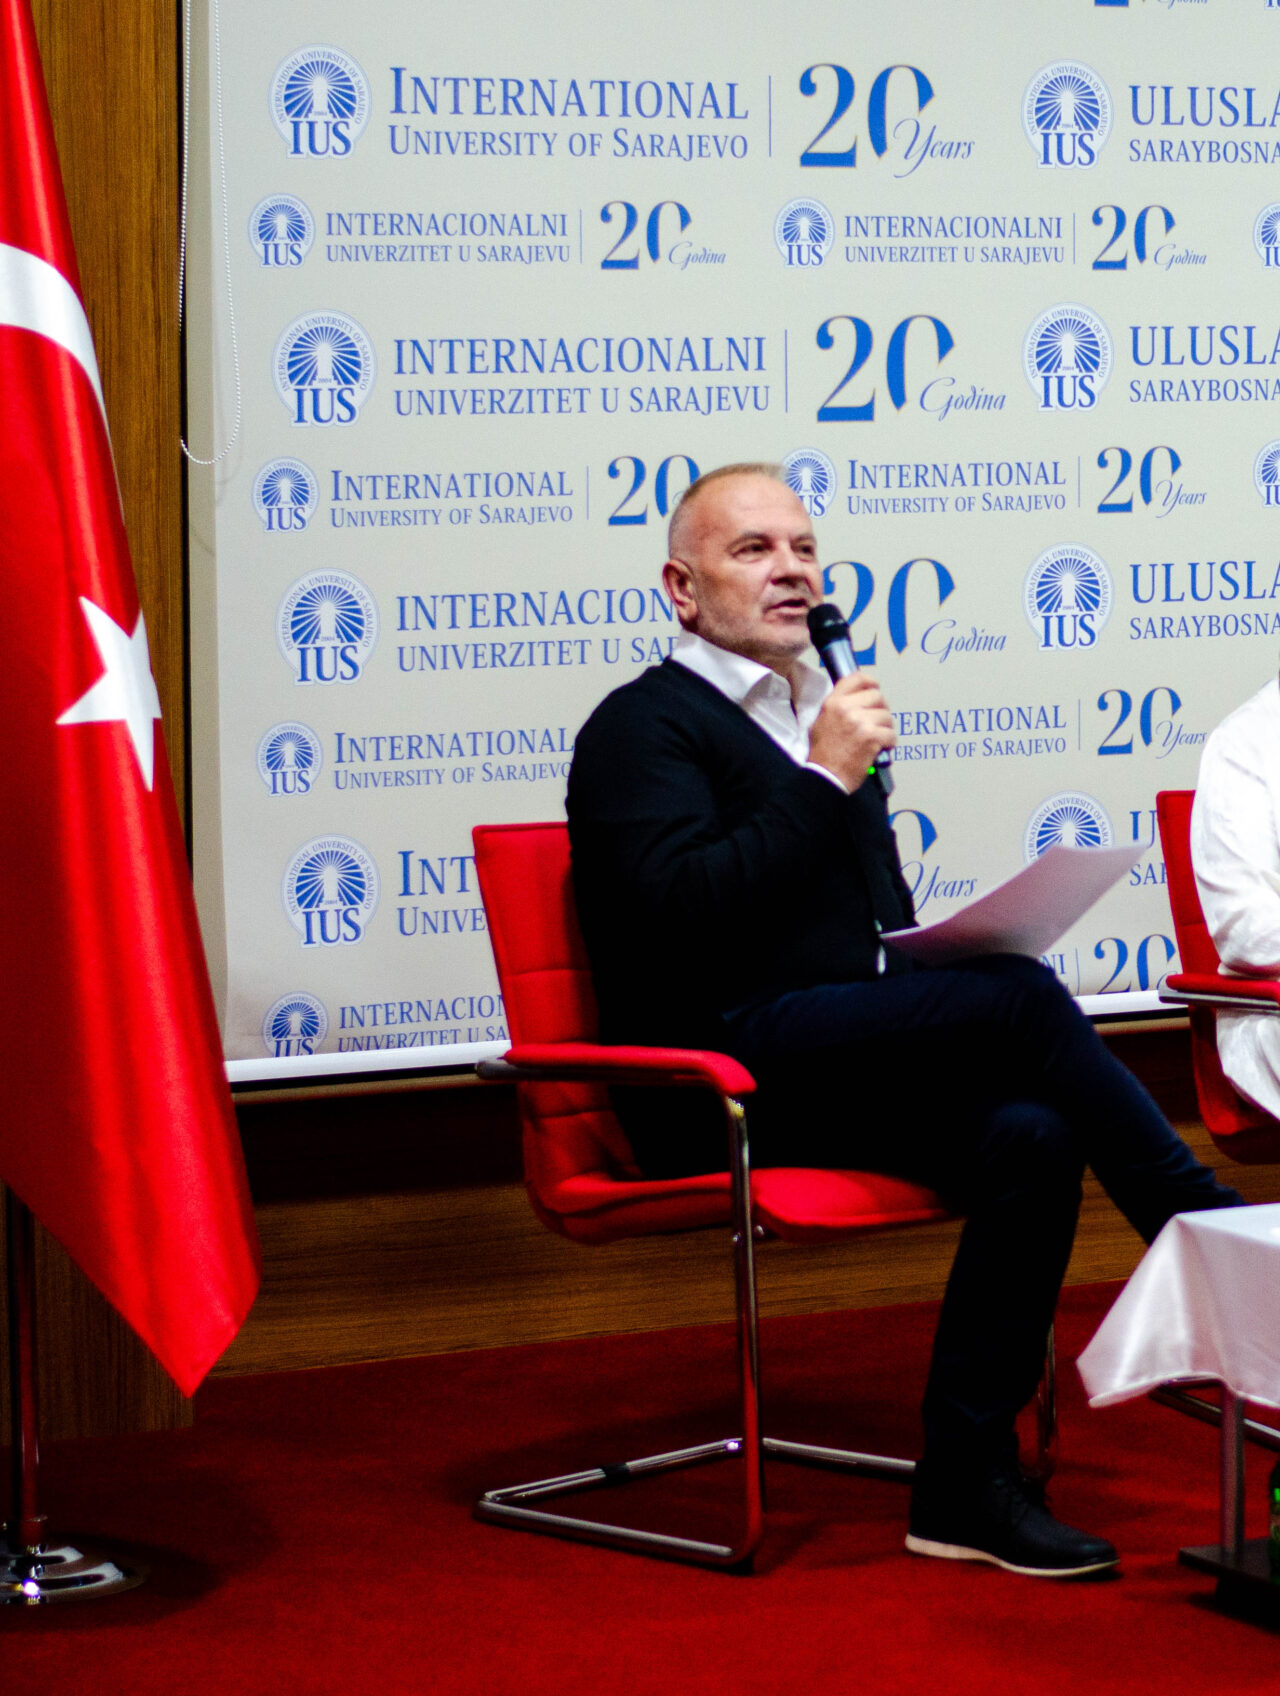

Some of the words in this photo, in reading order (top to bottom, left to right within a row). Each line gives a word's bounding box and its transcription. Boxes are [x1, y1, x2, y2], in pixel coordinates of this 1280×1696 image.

[389, 66, 750, 120] INTERNATIONAL
[289, 120, 351, 156] IUS
[800, 64, 937, 171] 20
[894, 117, 976, 179] Years
[388, 124, 557, 157] UNIVERSITY
[568, 132, 603, 157] OF
[612, 128, 748, 162] SARAJEVO
[1040, 132, 1095, 166] IUS
[326, 212, 568, 237] INTERNACIONALNI
[600, 201, 695, 270] 20
[667, 241, 727, 268] Godina
[845, 215, 1062, 239] INTERNACIONALNI
[1091, 205, 1178, 271] 20
[1153, 243, 1208, 269] Godina
[262, 243, 303, 266] IUS
[326, 244, 452, 262] UNIVERZITET
[458, 244, 471, 263] U
[477, 244, 570, 264] SARAJEVU
[784, 242, 824, 267] IUS
[844, 246, 959, 263] UNIVERZITET
[963, 246, 974, 263] U
[980, 246, 1064, 265] SARAJEVU
[393, 336, 766, 375] INTERNACIONALNI
[816, 315, 958, 422] 20
[920, 377, 1007, 420] Godina
[293, 387, 357, 423] IUS
[394, 387, 591, 416] UNIVERZITET
[600, 387, 619, 414] U
[629, 385, 770, 416] SARAJEVU
[1040, 374, 1096, 408] IUS
[331, 470, 574, 502] INTERNATIONAL
[607, 454, 700, 526] 20
[848, 459, 1066, 490] INTERNATIONAL
[1096, 447, 1184, 514] 20
[1156, 480, 1207, 519] Years
[265, 506, 307, 531] IUS
[330, 507, 441, 528] UNIVERSITY
[450, 508, 472, 525] OF
[479, 504, 573, 525] SARAJEVO
[799, 494, 825, 517] US
[848, 496, 949, 515] UNIVERSITY
[954, 496, 975, 512] OF
[981, 491, 1066, 512] SARAJEVO
[396, 588, 674, 632] INTERNACION
[819, 558, 956, 667] 20
[920, 620, 1007, 664] Godina
[1041, 613, 1096, 648] IUS
[296, 645, 360, 682] IUS
[397, 639, 592, 672] UNIVERZITET
[602, 638, 621, 664] U
[891, 704, 1067, 736] ERNATIONAL
[1097, 687, 1184, 757] 20
[1155, 720, 1207, 760] Years
[334, 727, 575, 764] INTERNATIONAL
[893, 743, 951, 762] ERSITY
[955, 742, 976, 758] OF
[982, 736, 1066, 757] SARAJEVO
[268, 770, 310, 796] IUS
[334, 768, 445, 790] UNIVERSITY
[451, 766, 475, 784] OF
[481, 761, 571, 783] SARAJEVO
[901, 861, 978, 914] Years
[302, 907, 361, 945] IUS
[397, 906, 486, 936] UNIVE
[1094, 934, 1176, 994] 20
[339, 994, 501, 1029] INTERNACIO
[275, 1038, 314, 1058] IUS
[338, 1028, 461, 1053] UNIVERZITET
[468, 1027, 479, 1043] U
